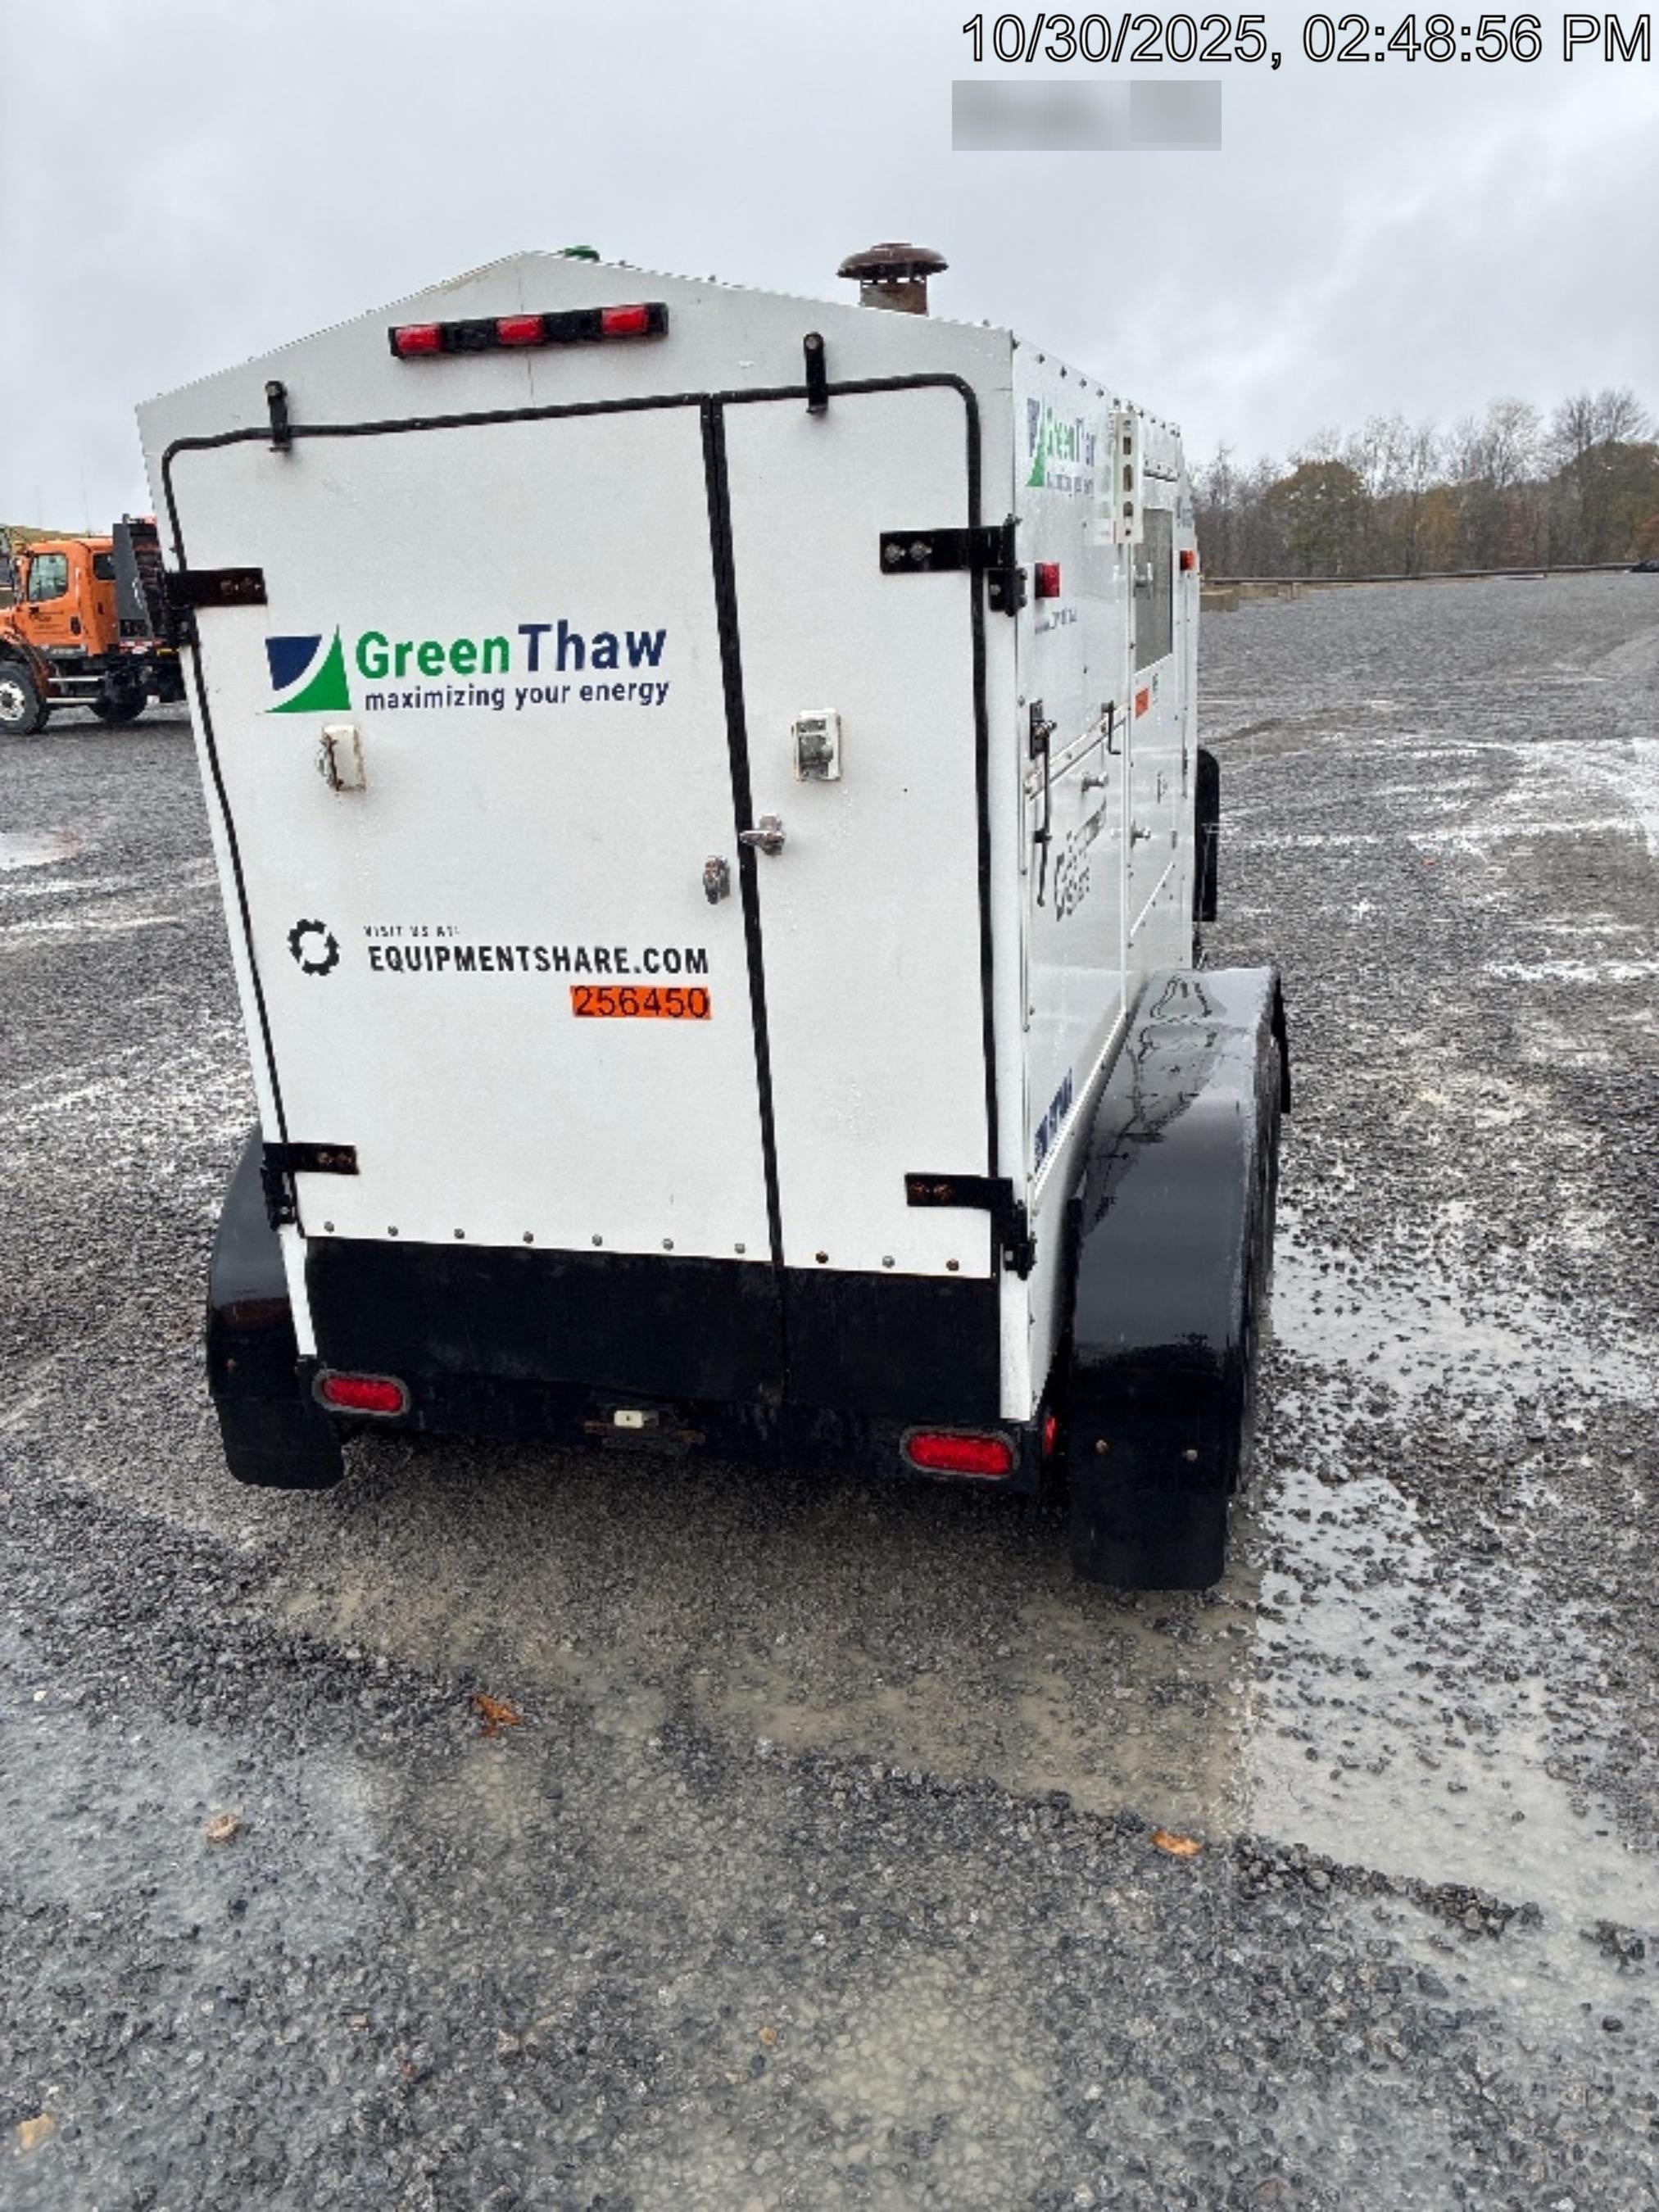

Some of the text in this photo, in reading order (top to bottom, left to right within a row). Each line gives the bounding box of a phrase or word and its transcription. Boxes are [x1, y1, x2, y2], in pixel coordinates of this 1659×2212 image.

[365, 680, 669, 711] maximizing your energy
[363, 925, 402, 938] VISIT
[368, 945, 709, 975] EQUIPMENTSHARE.COM
[573, 986, 709, 1018] 256450
